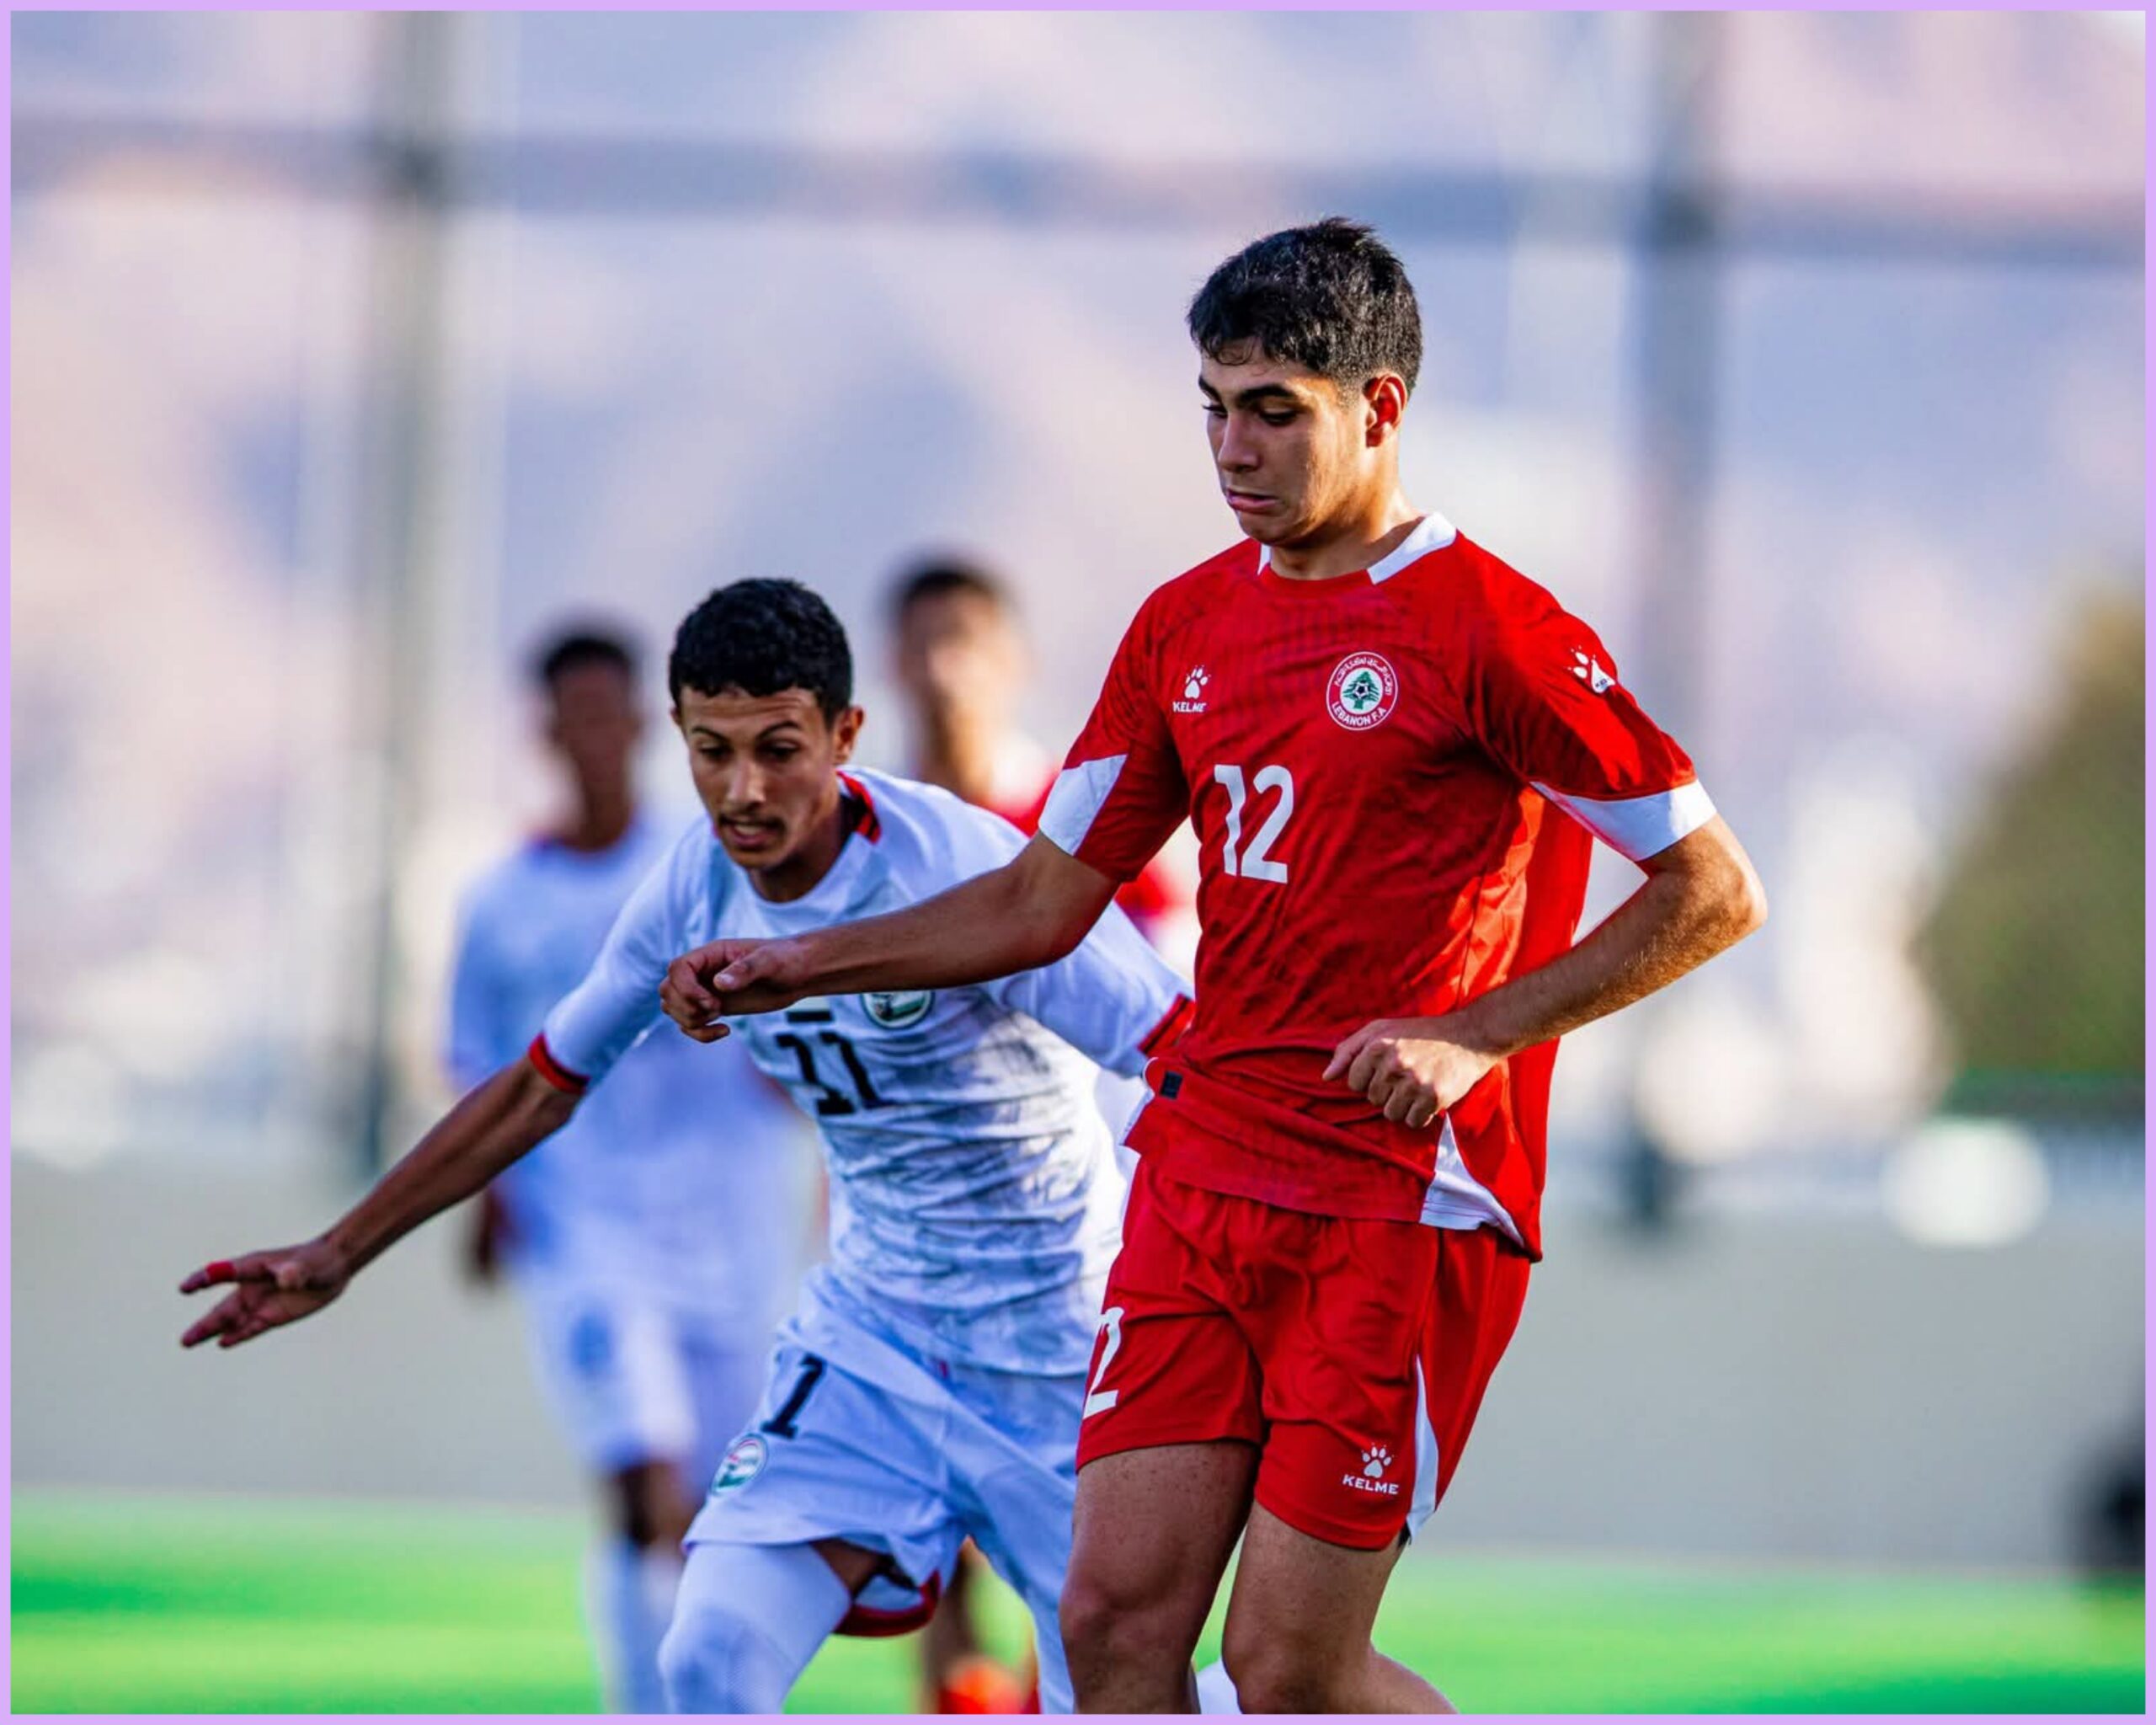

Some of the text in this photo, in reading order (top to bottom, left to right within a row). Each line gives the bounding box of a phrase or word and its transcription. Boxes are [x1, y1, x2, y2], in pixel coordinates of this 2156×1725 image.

[1331, 701, 1371, 726] LEBANON
[1214, 764, 1294, 884] 12
[775, 1032, 881, 1116] 11
[1342, 1473, 1399, 1495] KELME
